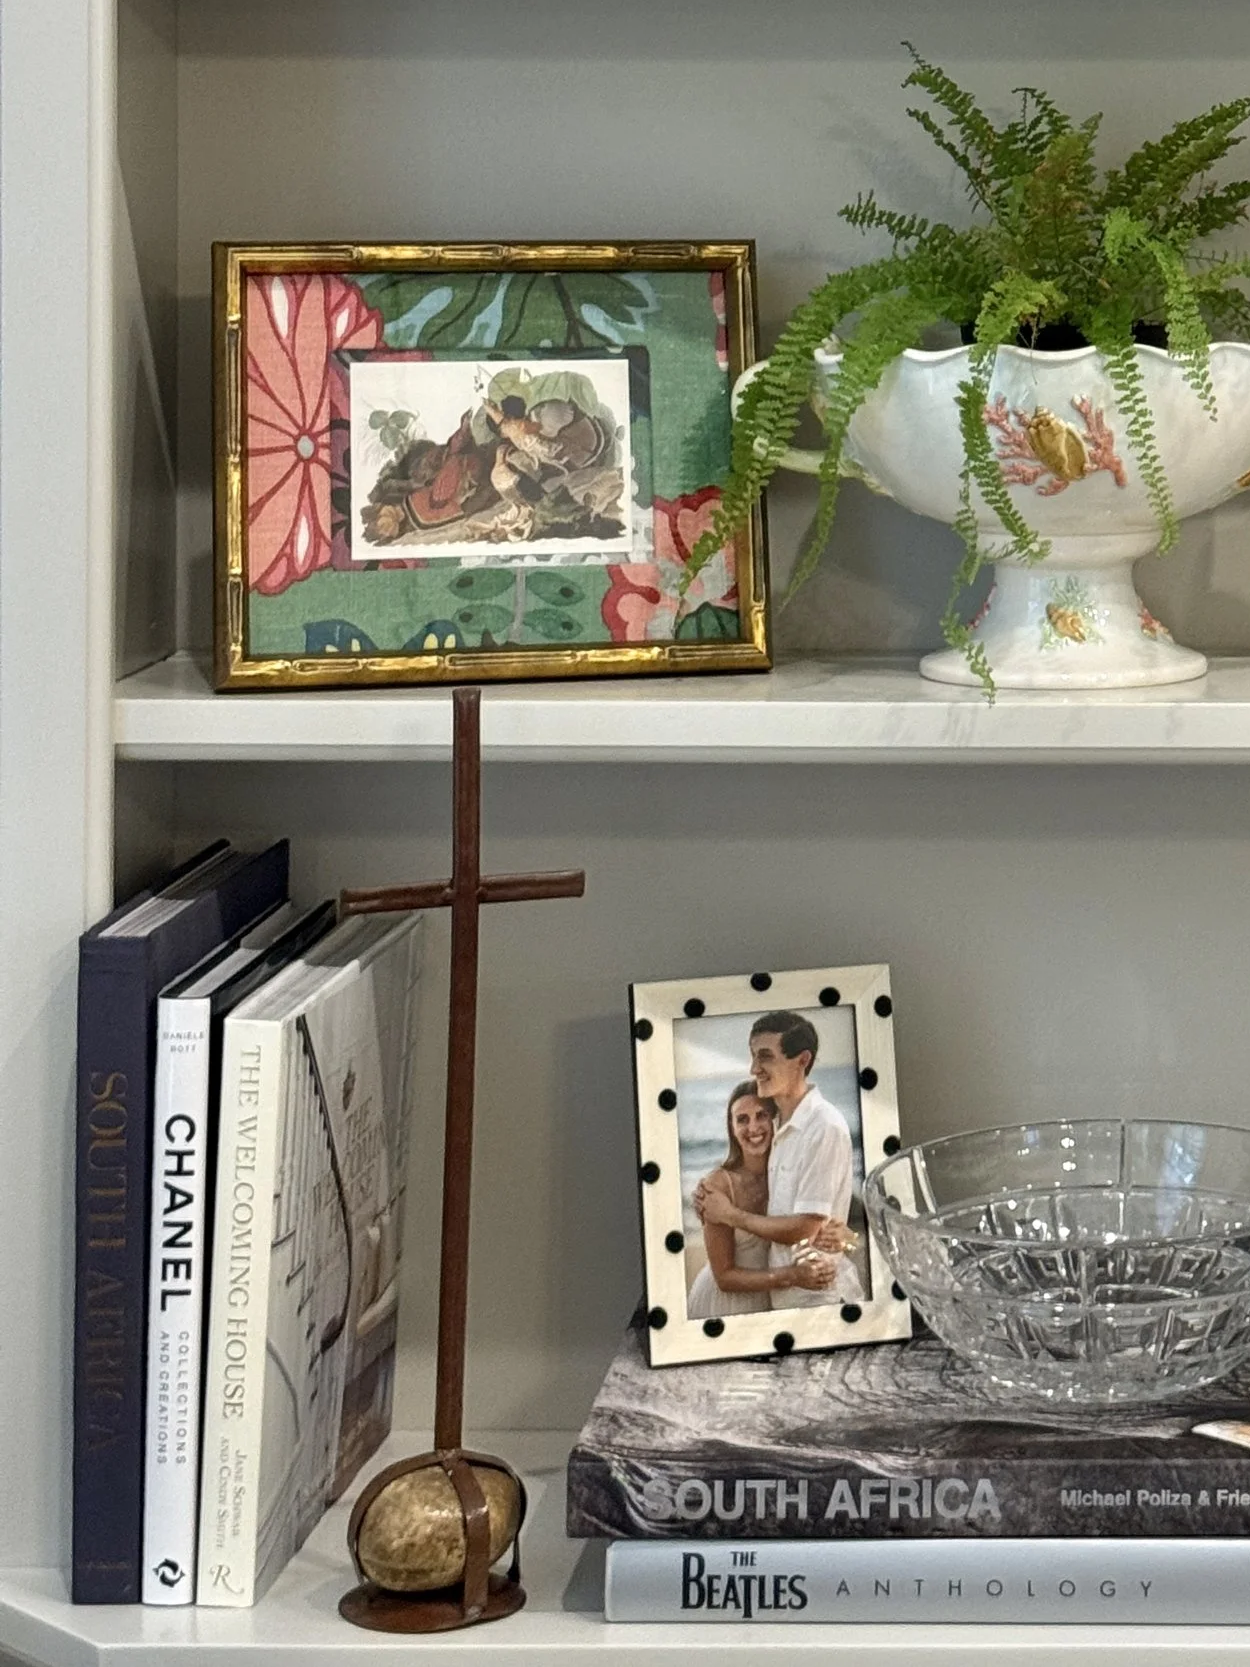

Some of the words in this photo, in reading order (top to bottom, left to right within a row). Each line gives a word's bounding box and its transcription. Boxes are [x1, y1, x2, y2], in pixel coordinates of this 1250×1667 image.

[239, 1045, 261, 1107] THE
[87, 1071, 128, 1249] SOUTH
[160, 1113, 196, 1312] CHANEL
[228, 1115, 258, 1308] WELCOMING
[160, 1330, 170, 1364] AND
[222, 1317, 248, 1420] HOUSE
[156, 1370, 170, 1465] CREATIONS
[176, 1330, 190, 1466] COLLECTIONS
[642, 1478, 808, 1521] SOUTH
[824, 1478, 1002, 1521] AFRICA
[1060, 1489, 1131, 1507] Michael
[1136, 1489, 1192, 1507] Poliza
[1198, 1491, 1211, 1506] &
[681, 1551, 809, 1619] BEATLES
[835, 1578, 1154, 1599] ANTHOLOGY
[731, 1551, 758, 1567] THE
